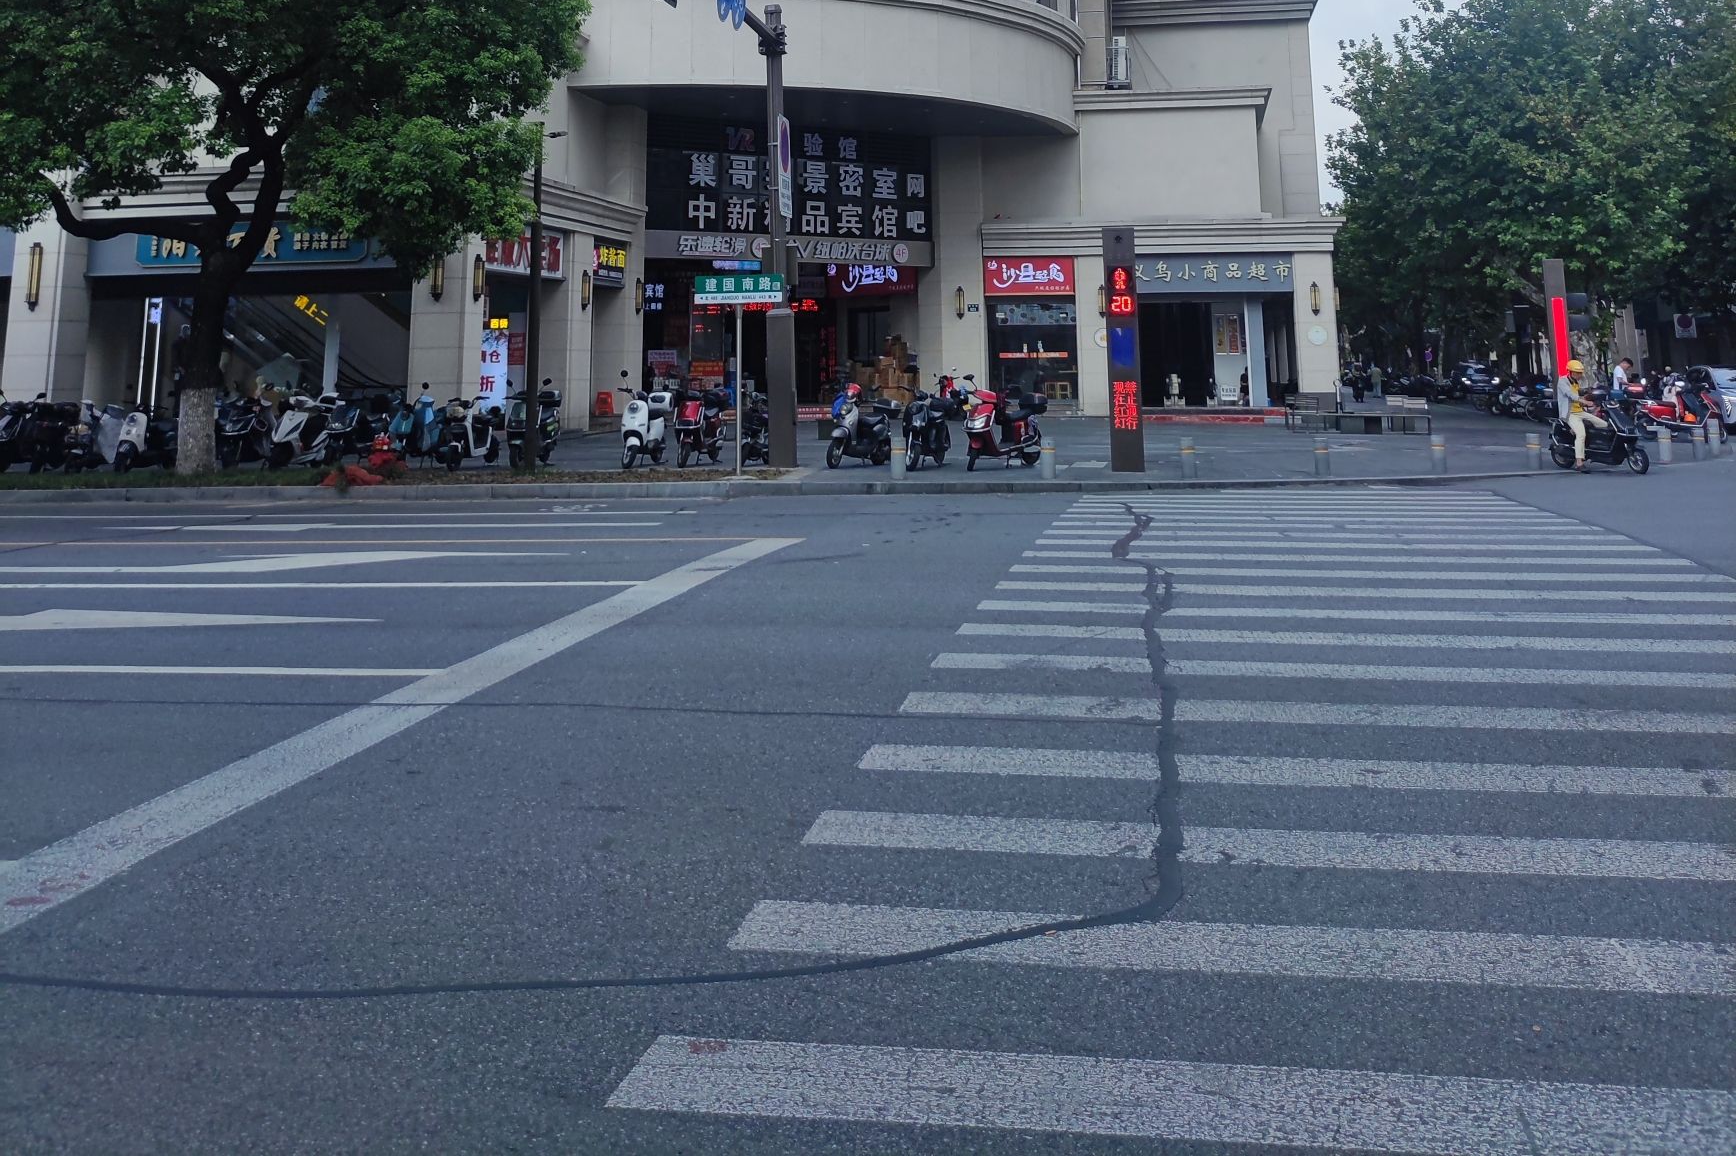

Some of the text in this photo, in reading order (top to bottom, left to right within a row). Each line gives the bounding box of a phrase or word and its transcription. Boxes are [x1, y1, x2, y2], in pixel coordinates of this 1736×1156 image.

[726, 126, 857, 160] VR验馆
[689, 152, 898, 200] 巢哥景密室
[645, 284, 664, 298] 宾馆
[705, 277, 771, 292] 建国南路
[1111, 296, 1132, 312] 20
[480, 376, 495, 392] 折
[1113, 381, 1126, 429] 现在红灯
[1125, 381, 1138, 429] 禁止通行
